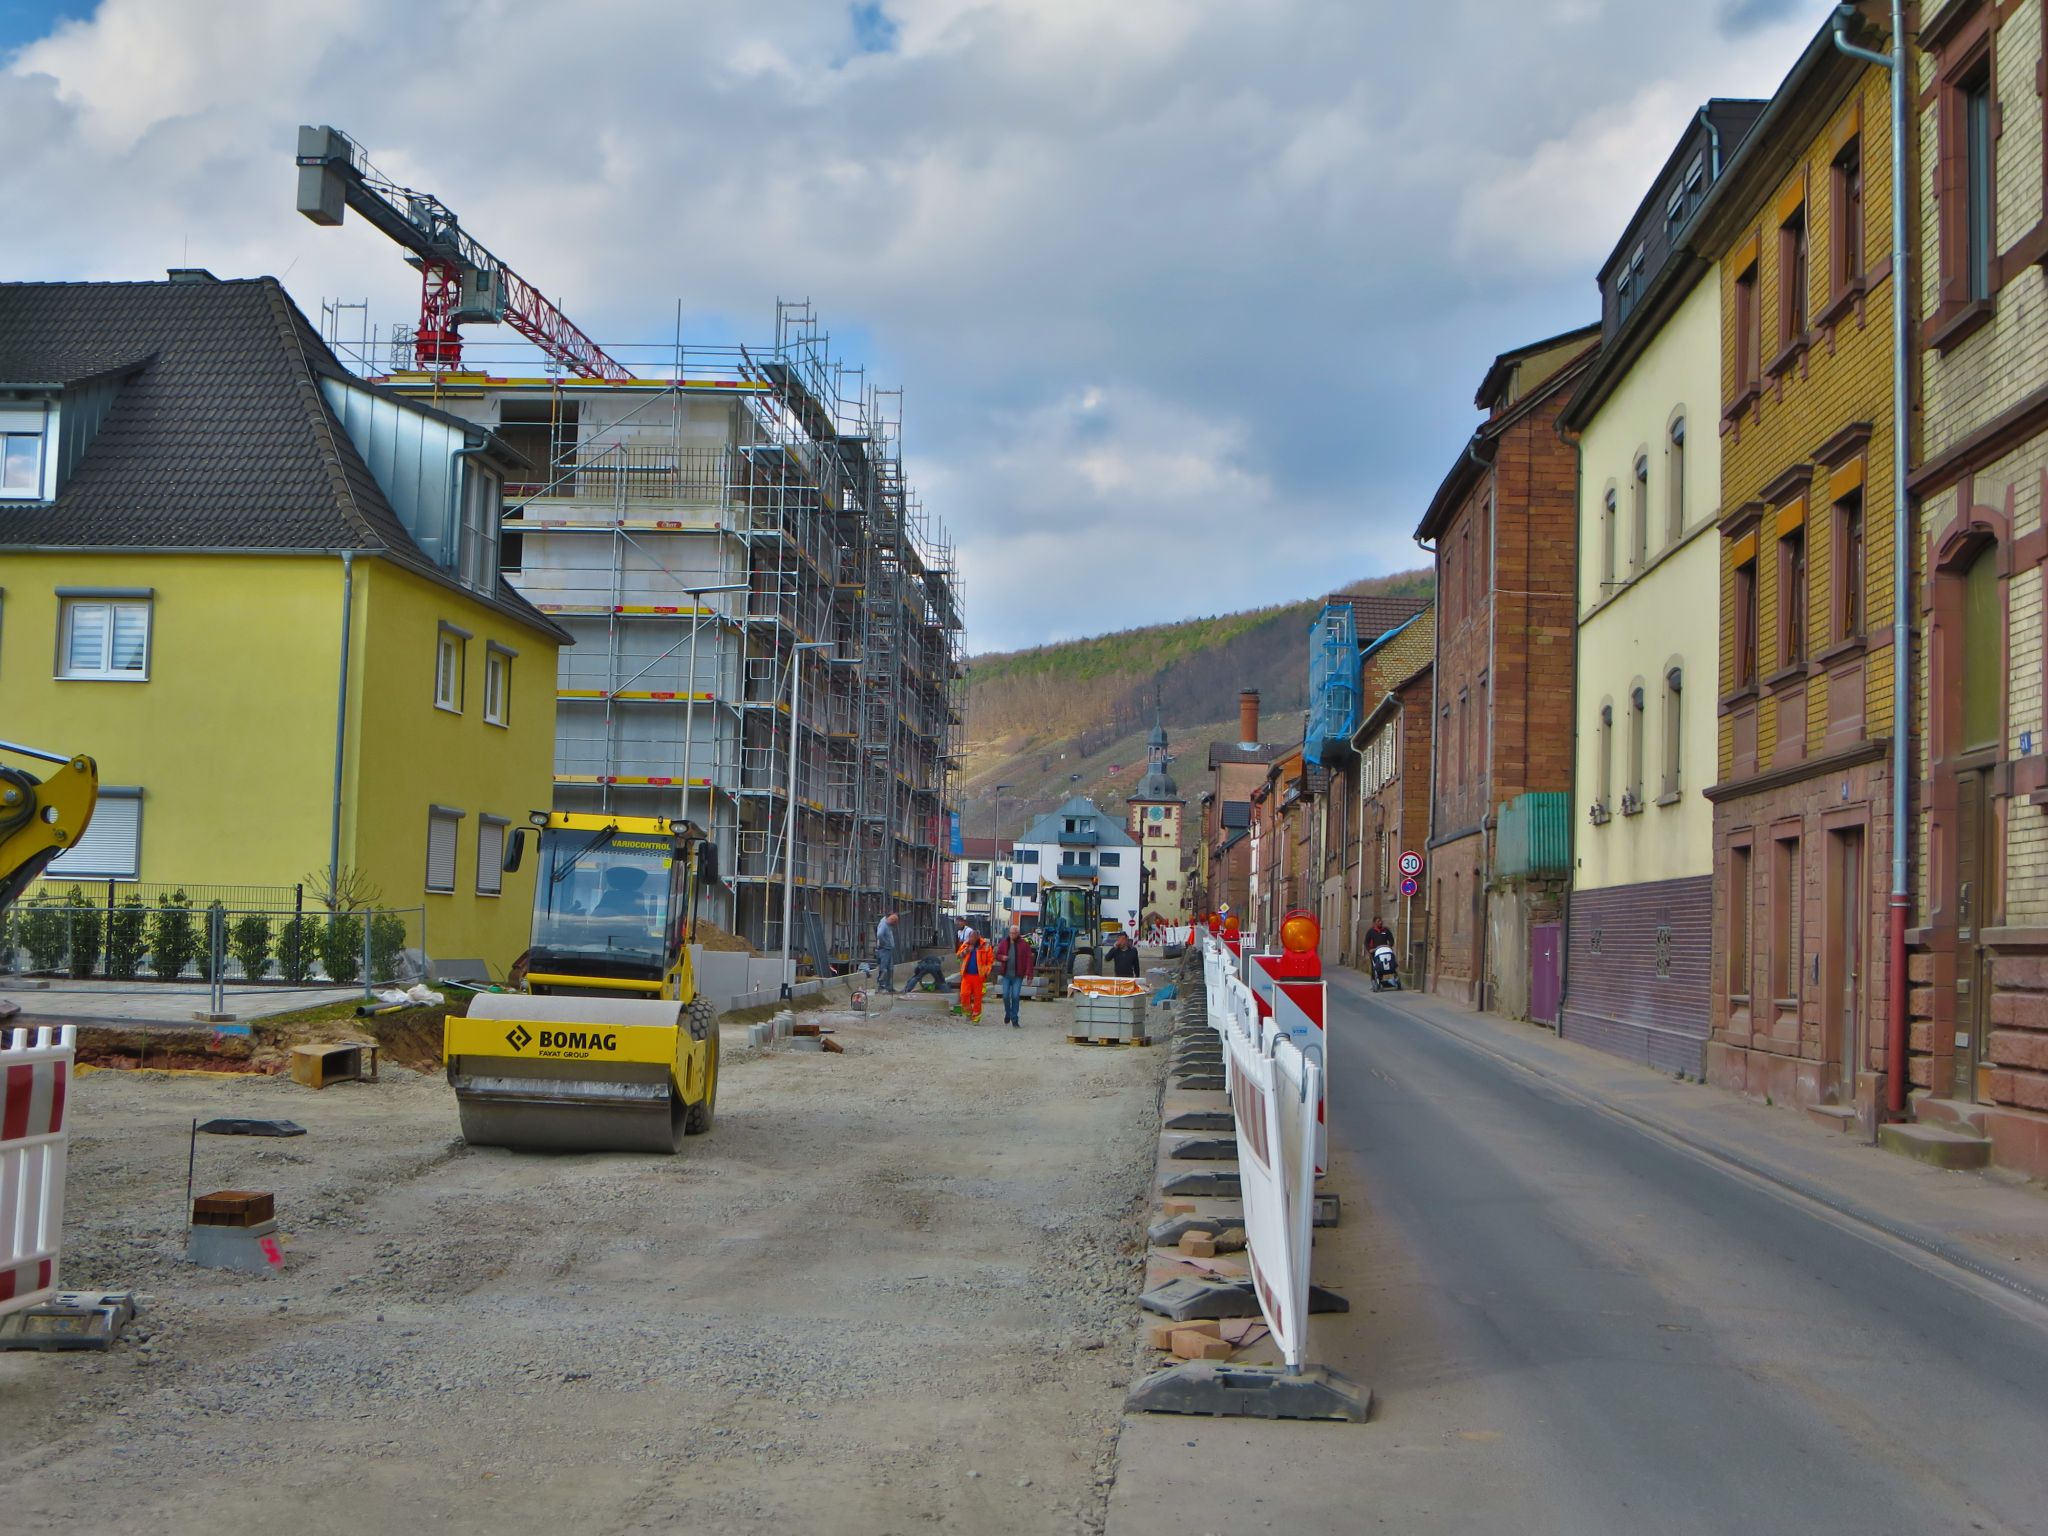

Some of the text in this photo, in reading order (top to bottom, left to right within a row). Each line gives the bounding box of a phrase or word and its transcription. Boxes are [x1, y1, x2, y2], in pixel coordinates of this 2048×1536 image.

[611, 839, 671, 850] VARIOCONTROL
[1403, 858, 1418, 870] 30
[539, 1031, 617, 1051] BOMAG
[563, 1051, 589, 1059] GROUP
